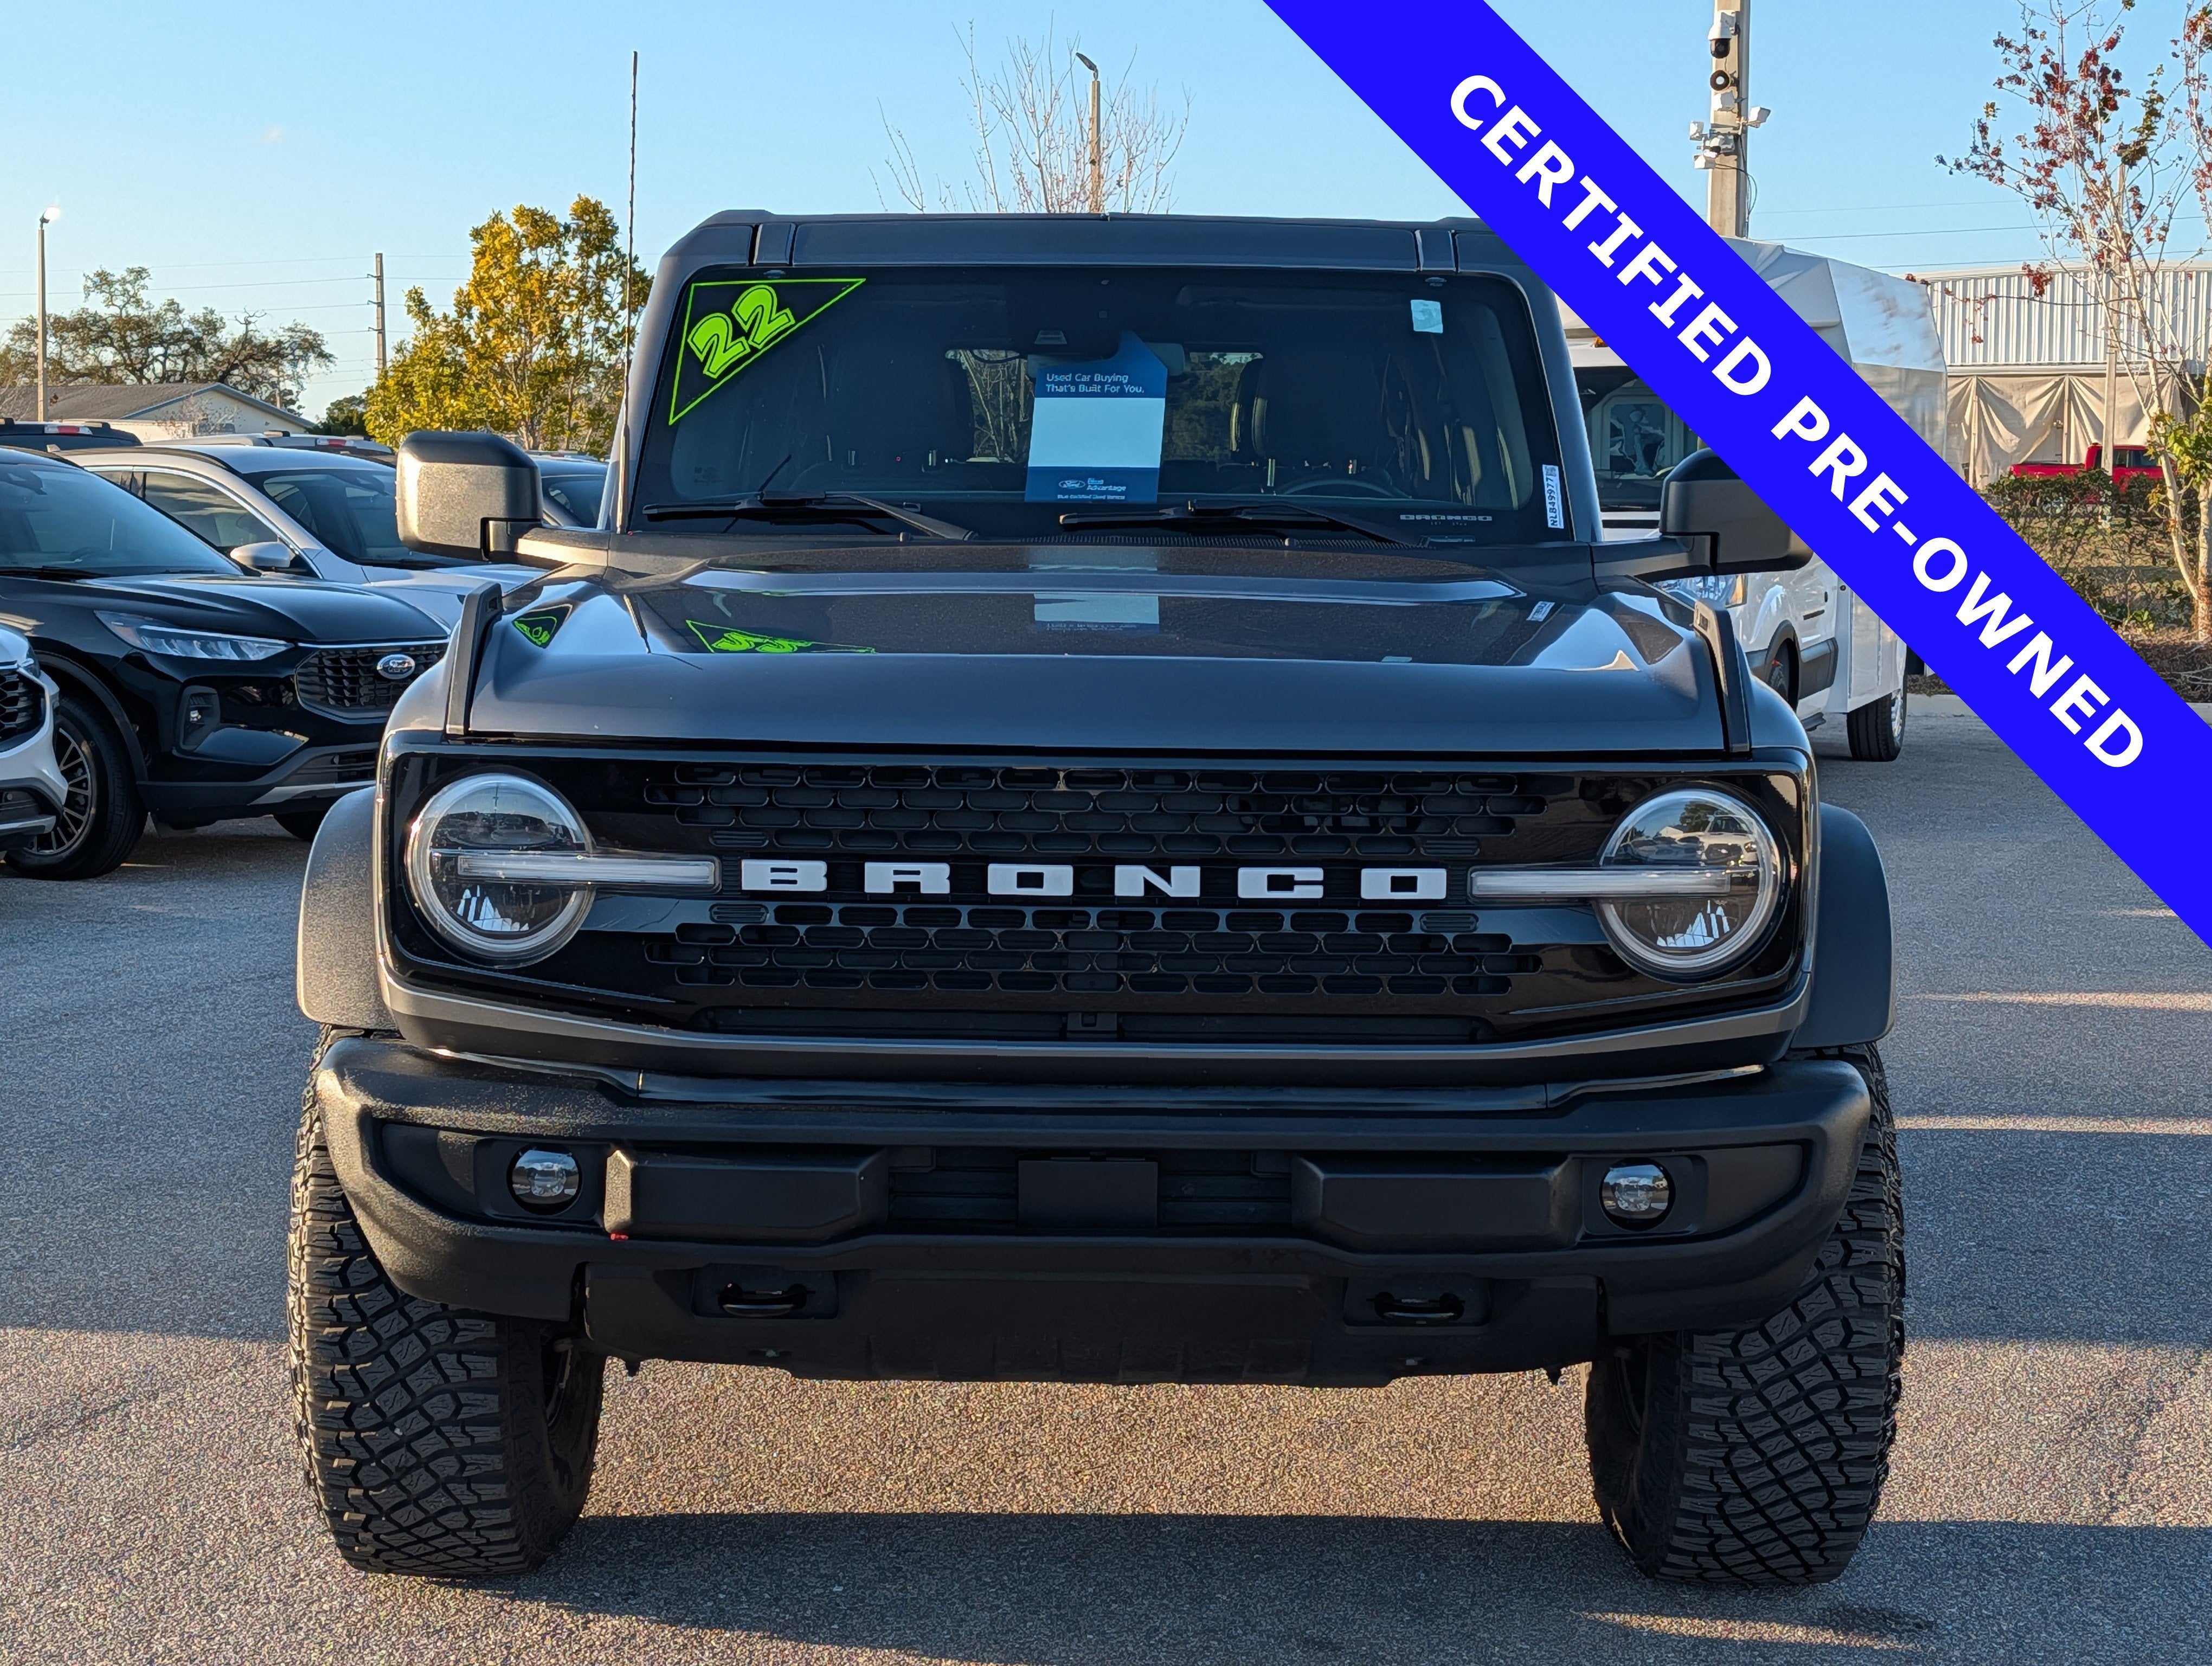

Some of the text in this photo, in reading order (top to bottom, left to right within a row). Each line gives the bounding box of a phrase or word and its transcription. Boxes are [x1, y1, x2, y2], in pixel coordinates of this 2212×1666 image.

[688, 285, 795, 378] 22
[1045, 383, 1144, 394] That's Built For You.
[1046, 373, 1129, 383] Used Car Buying
[1546, 477, 1558, 526] NLB49977
[742, 861, 1446, 899] BRONCO
